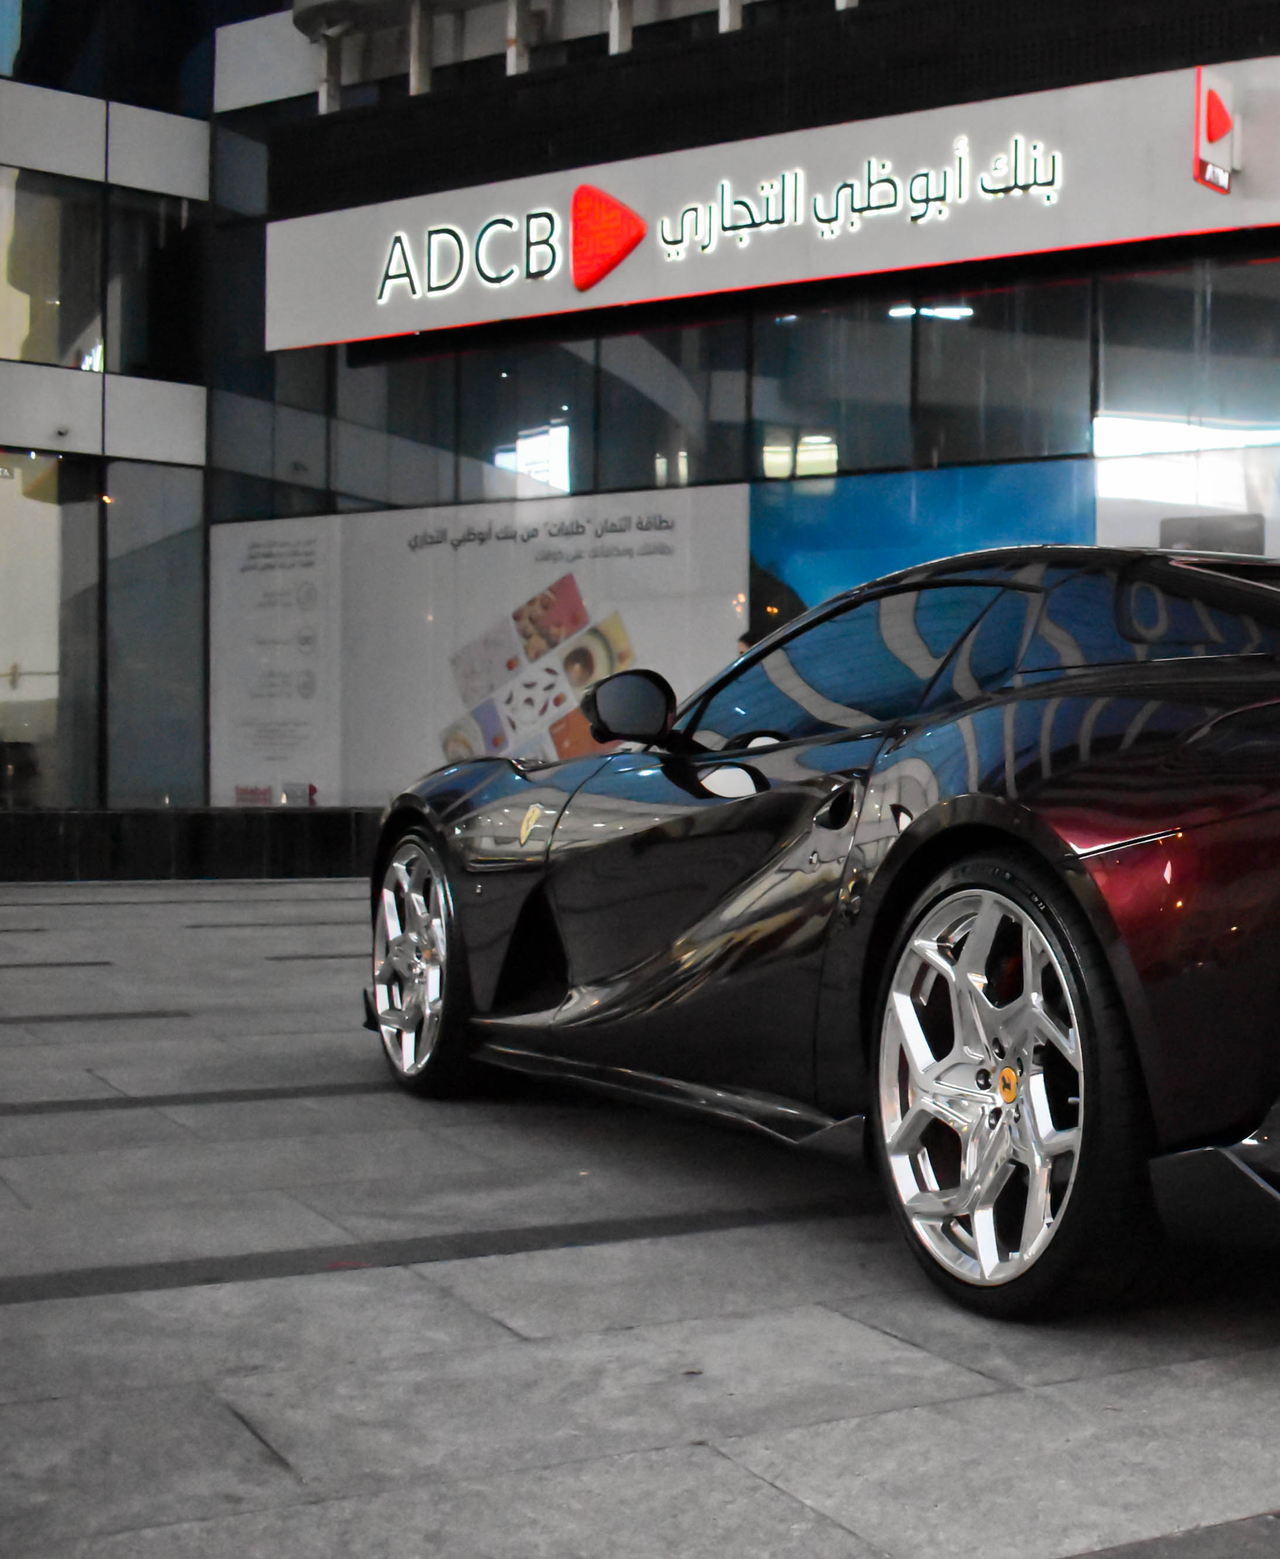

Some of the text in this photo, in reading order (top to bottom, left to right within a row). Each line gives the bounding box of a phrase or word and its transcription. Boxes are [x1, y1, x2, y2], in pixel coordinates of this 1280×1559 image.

[658, 134, 1062, 261] بنك أبوظبي التجاري
[376, 208, 562, 304] ADCB
